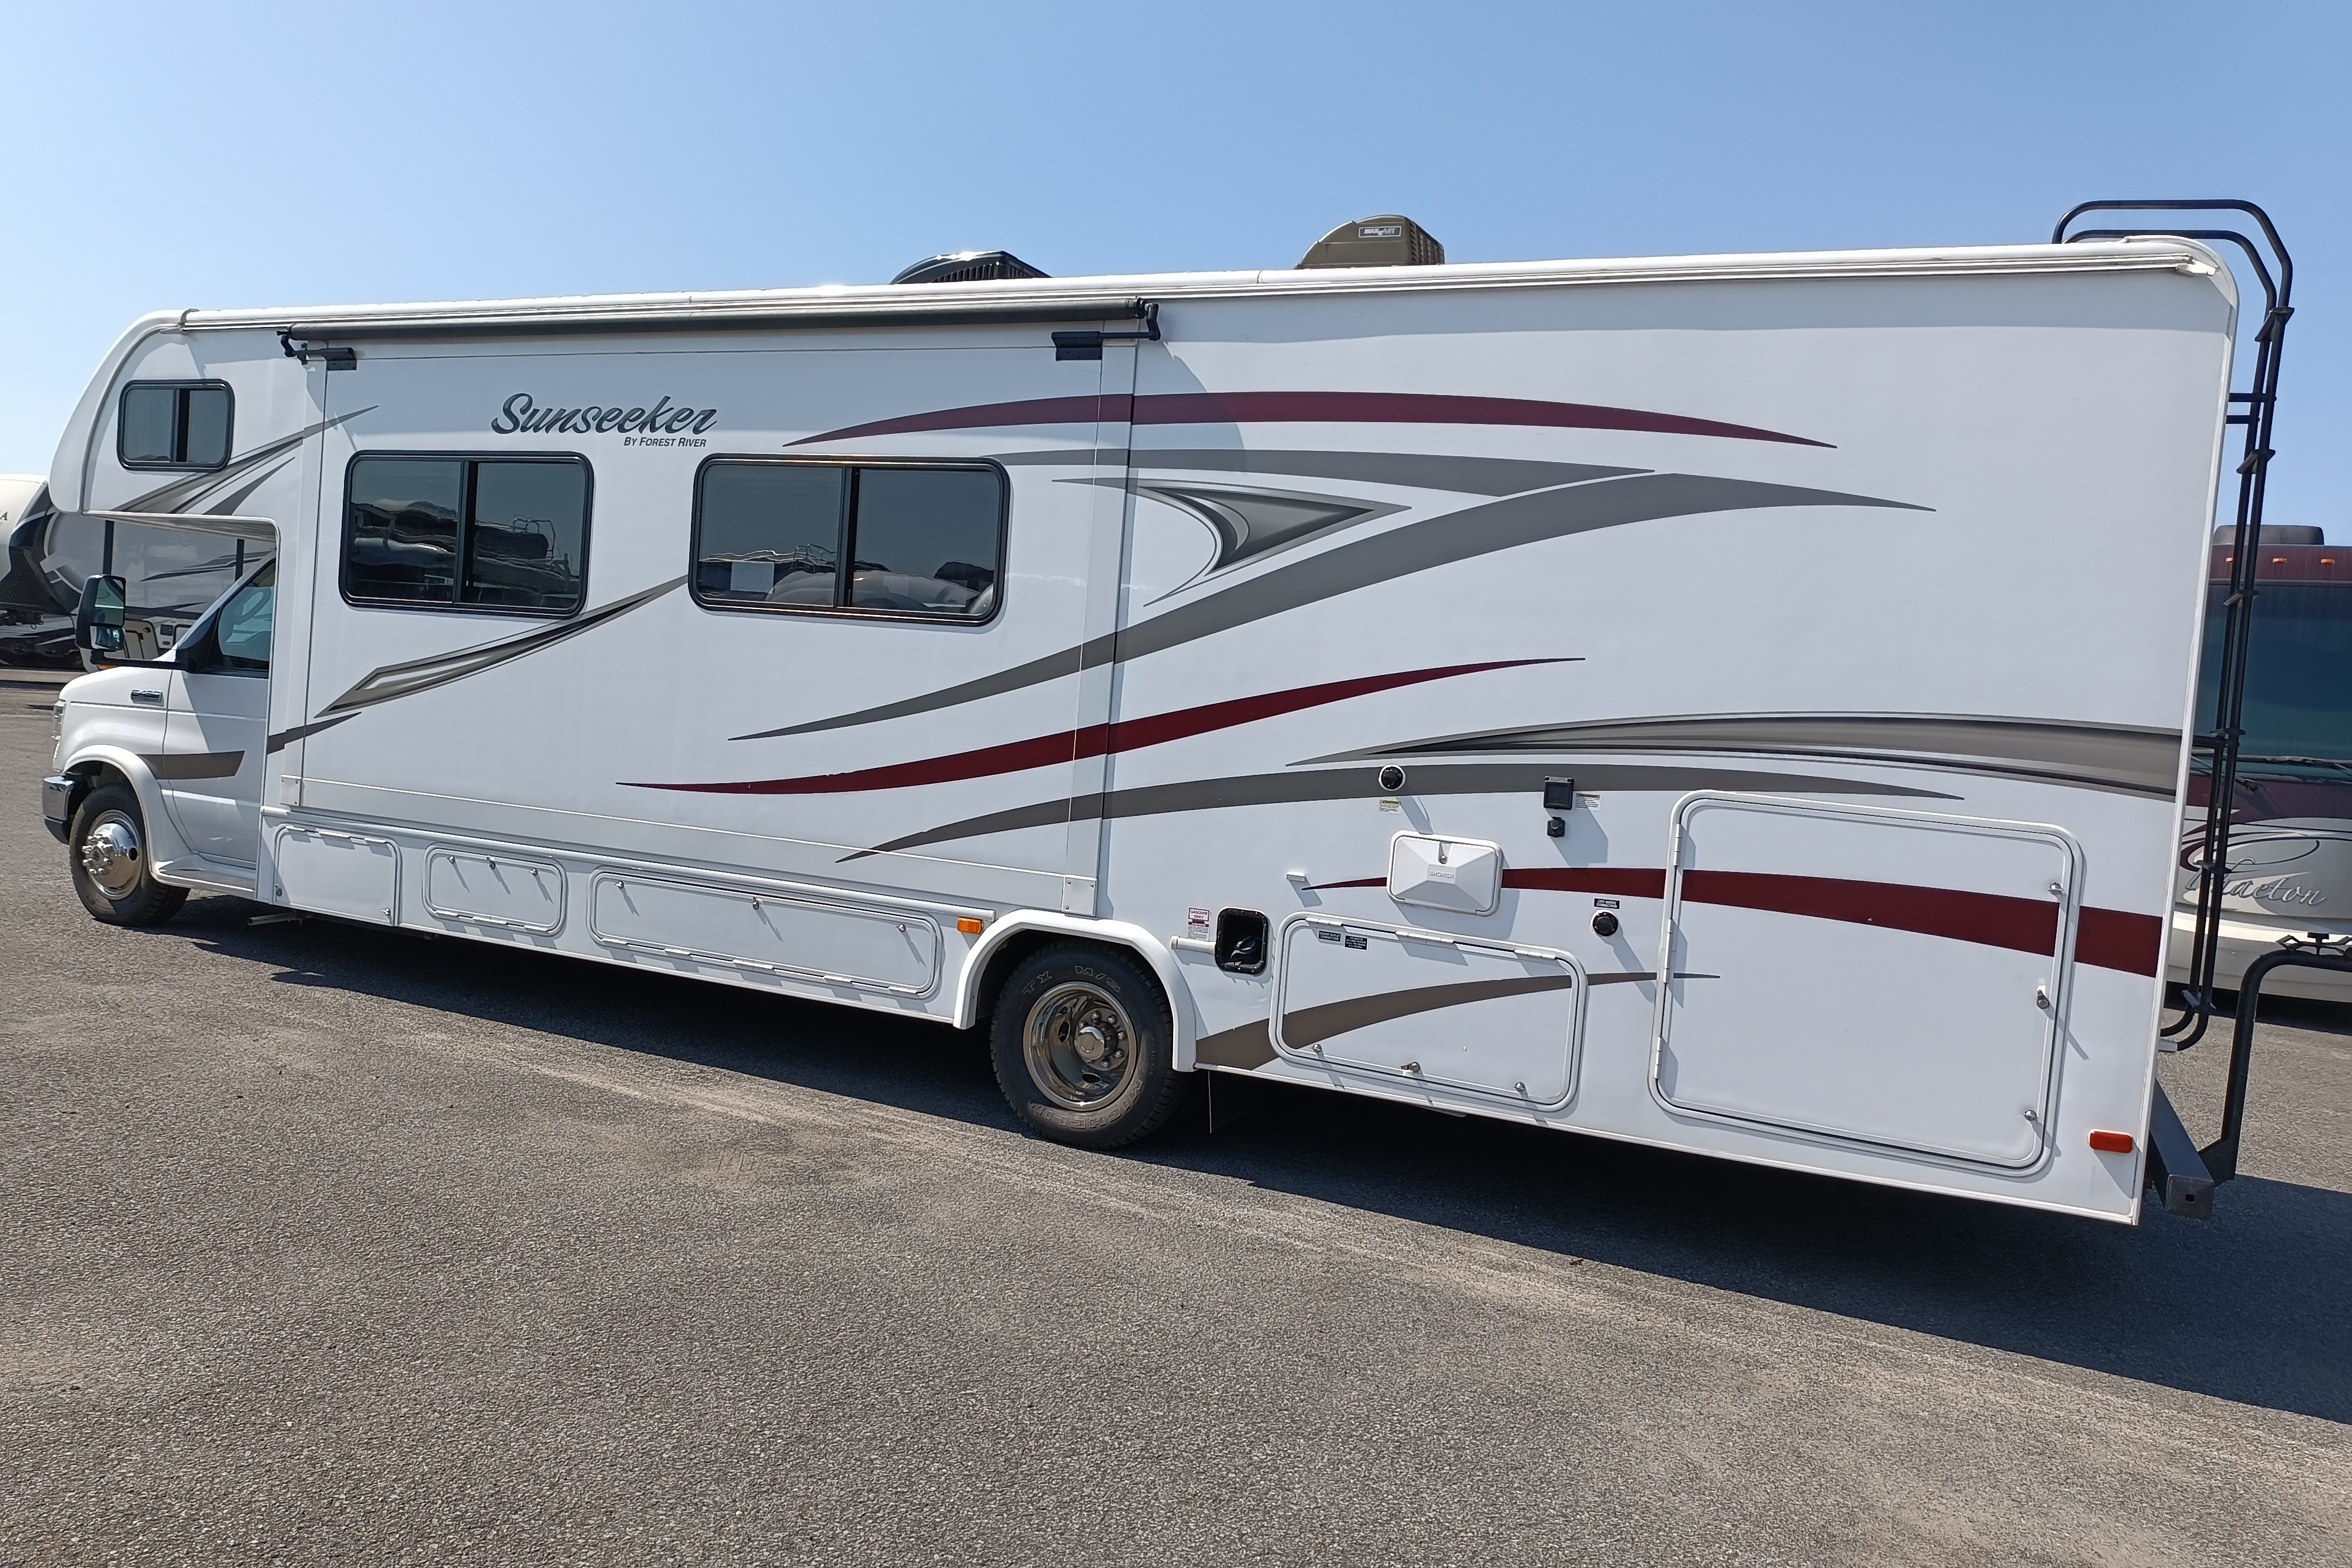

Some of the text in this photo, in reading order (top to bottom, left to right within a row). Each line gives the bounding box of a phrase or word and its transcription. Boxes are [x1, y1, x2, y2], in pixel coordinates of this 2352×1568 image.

[491, 393, 717, 435] Sunseeker
[640, 437, 676, 447] FOREST
[678, 437, 707, 448] RIVER
[1429, 870, 1455, 879] SHOWER
[1075, 965, 1121, 992] M/S
[1027, 1078, 1144, 1129] MICHELIN
